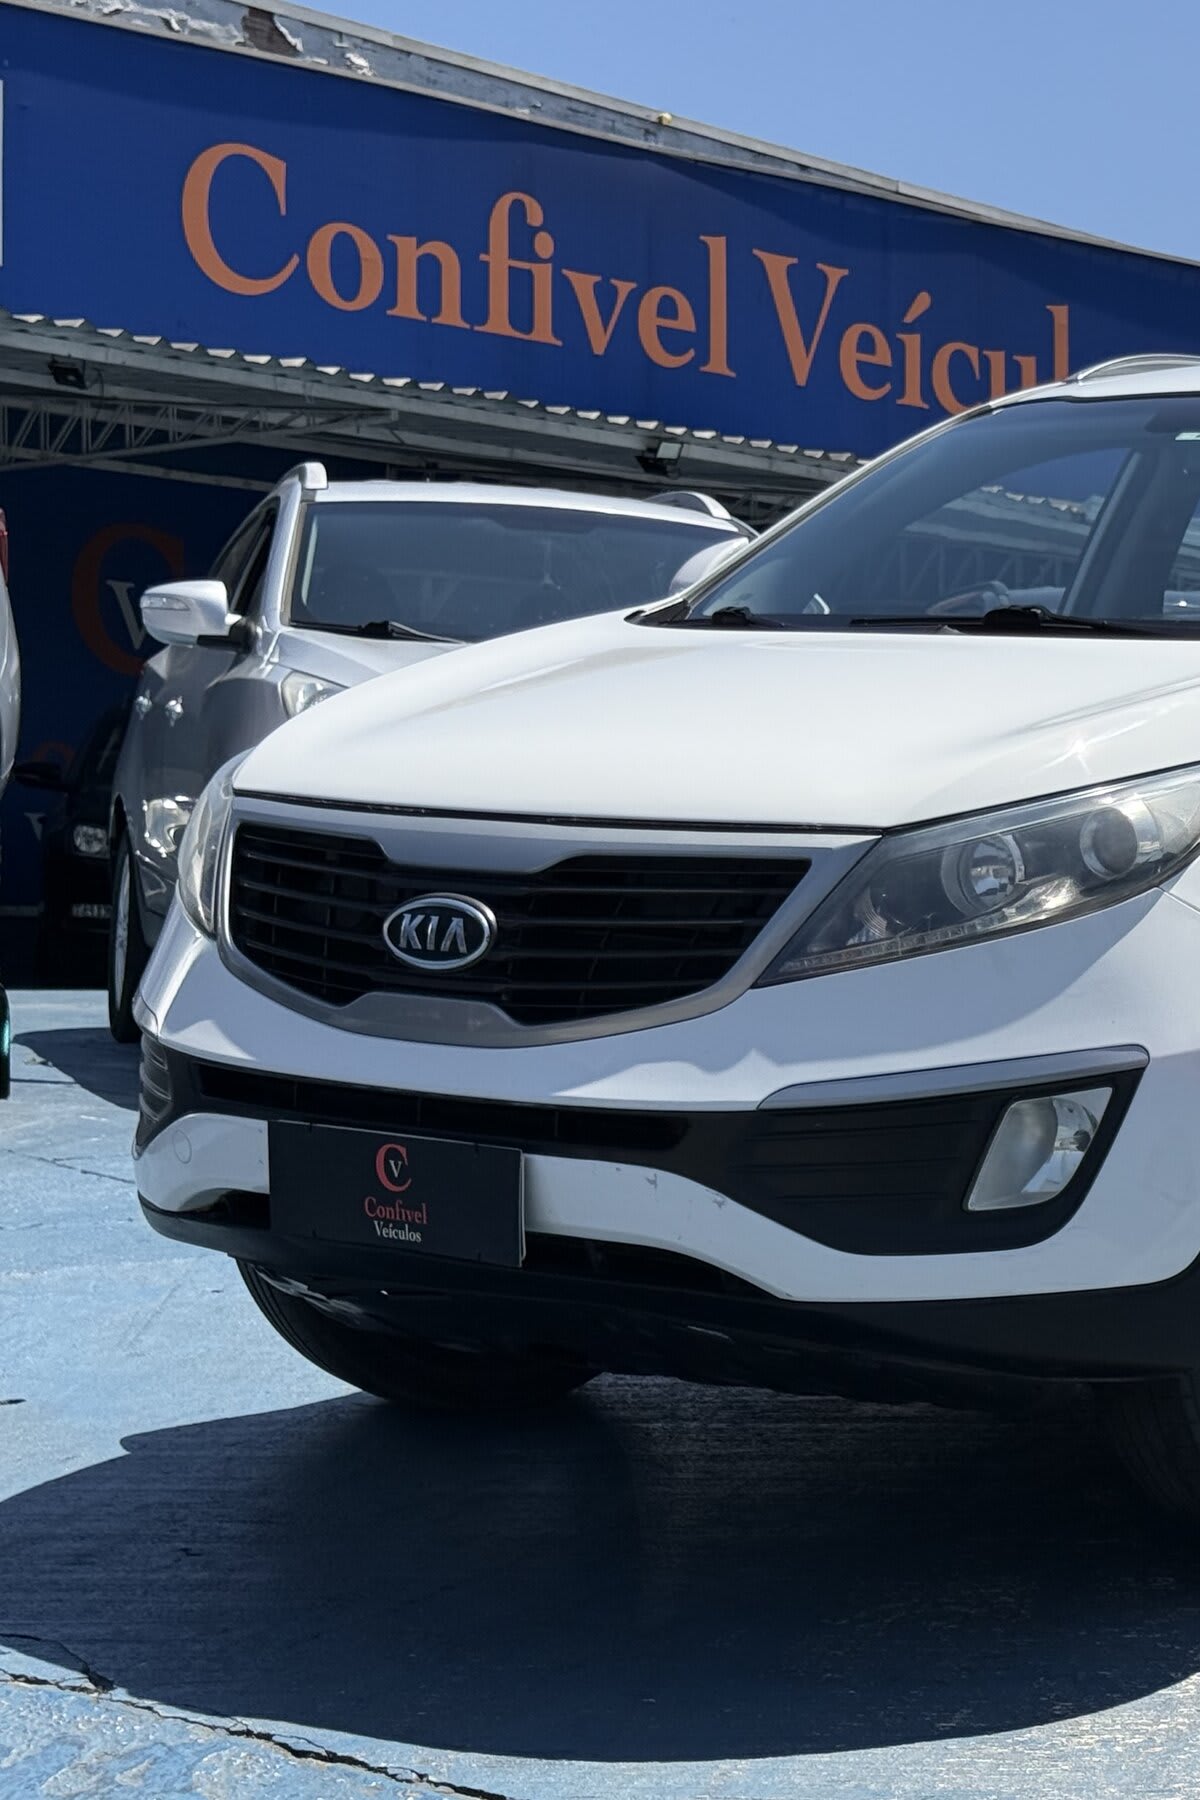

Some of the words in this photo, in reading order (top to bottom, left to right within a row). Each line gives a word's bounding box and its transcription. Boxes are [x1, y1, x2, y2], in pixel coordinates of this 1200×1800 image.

[181, 143, 737, 377] Confivel
[399, 913, 468, 954] KIA
[365, 1196, 427, 1224] Confivel
[374, 1220, 422, 1242] Veículos
